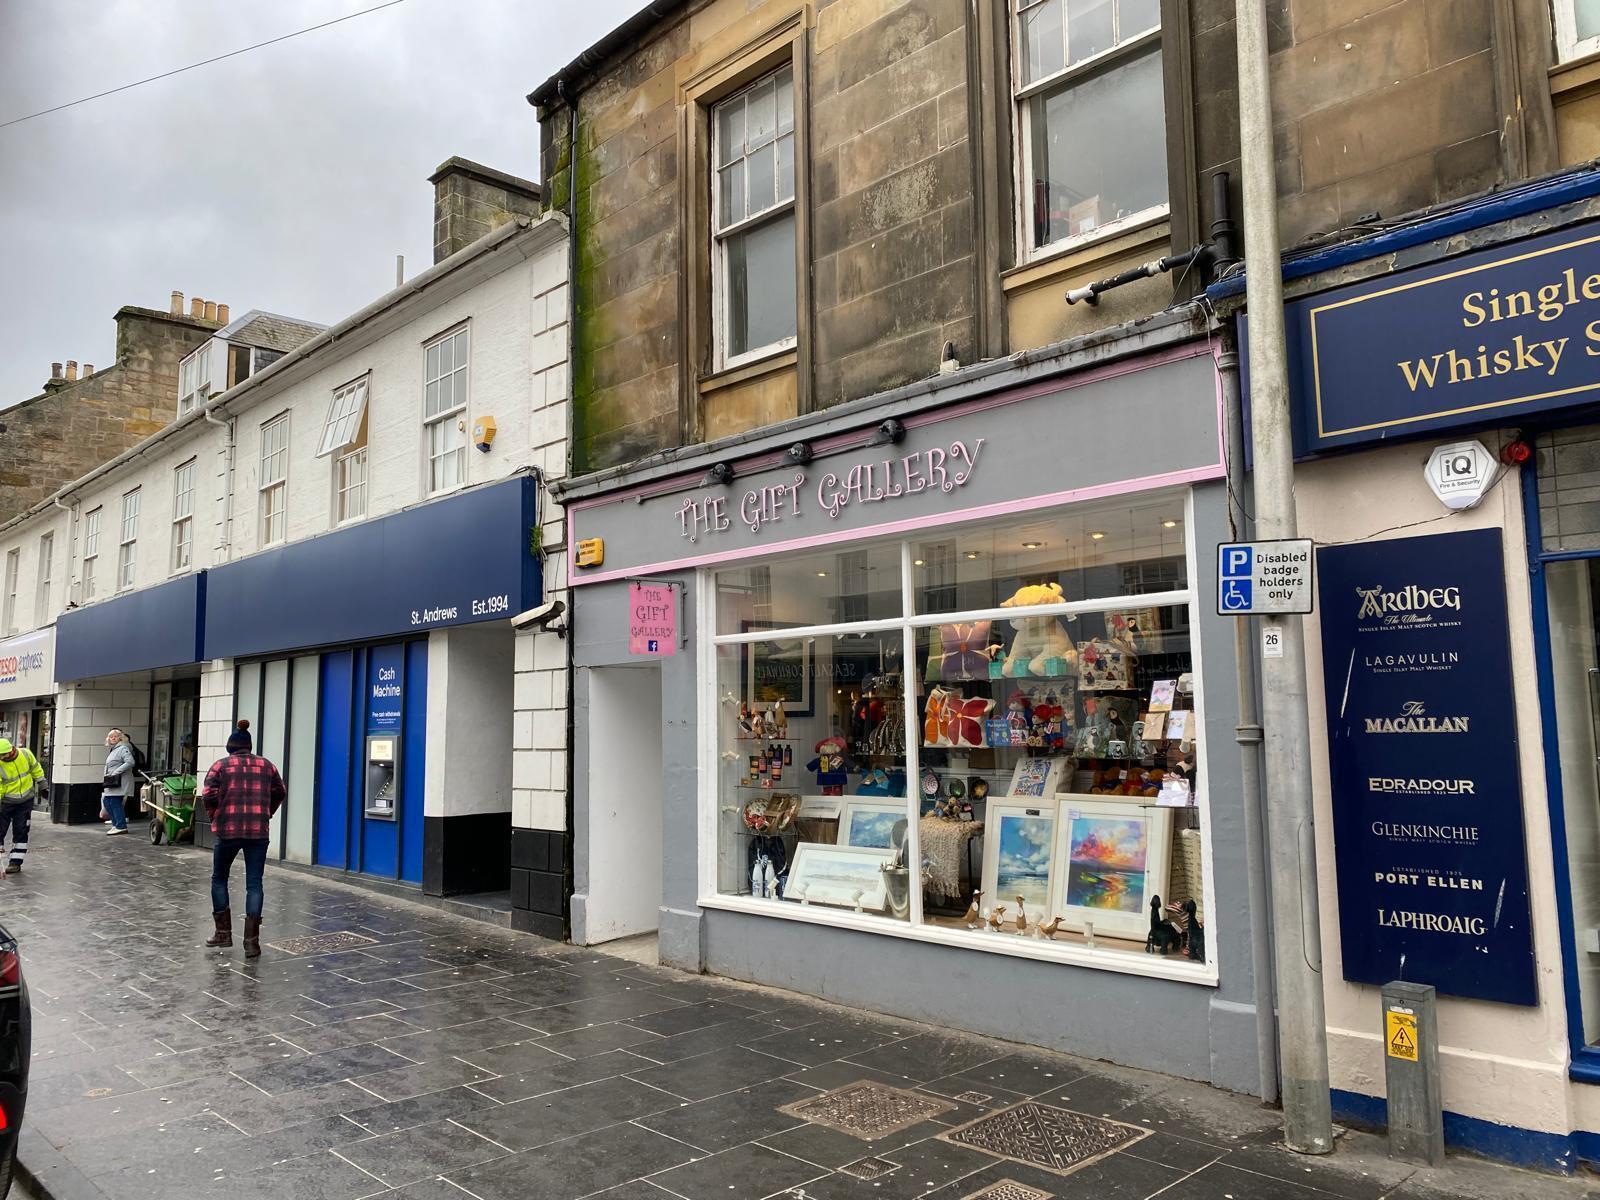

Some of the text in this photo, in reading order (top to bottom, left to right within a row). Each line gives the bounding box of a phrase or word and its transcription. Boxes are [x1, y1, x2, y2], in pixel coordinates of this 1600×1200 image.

[1462, 268, 1600, 328] Single
[1397, 335, 1569, 391] Whisky
[674, 438, 986, 543] THE GIFT GALLERY
[1256, 552, 1307, 564] Disabled
[1263, 565, 1300, 576] badge
[1259, 577, 1304, 587] holders
[644, 589, 662, 602] THE
[1268, 588, 1294, 600] only
[411, 594, 509, 625] St. Andrews Est.1994
[636, 604, 670, 623] GIFT
[631, 625, 674, 638] GALLERY
[1265, 634, 1278, 645] 26
[1365, 652, 1459, 667] LAGAVULIN
[379, 667, 396, 681] Cash
[373, 684, 401, 698] Machine
[1399, 701, 1426, 717] The
[1364, 716, 1470, 734] MACALLAN
[1368, 777, 1475, 794] EDRADOUR
[1371, 821, 1479, 841] GLENKINCHIE
[1375, 872, 1483, 891] PORT ELLEN
[1377, 908, 1486, 936] LAPHROAIG
